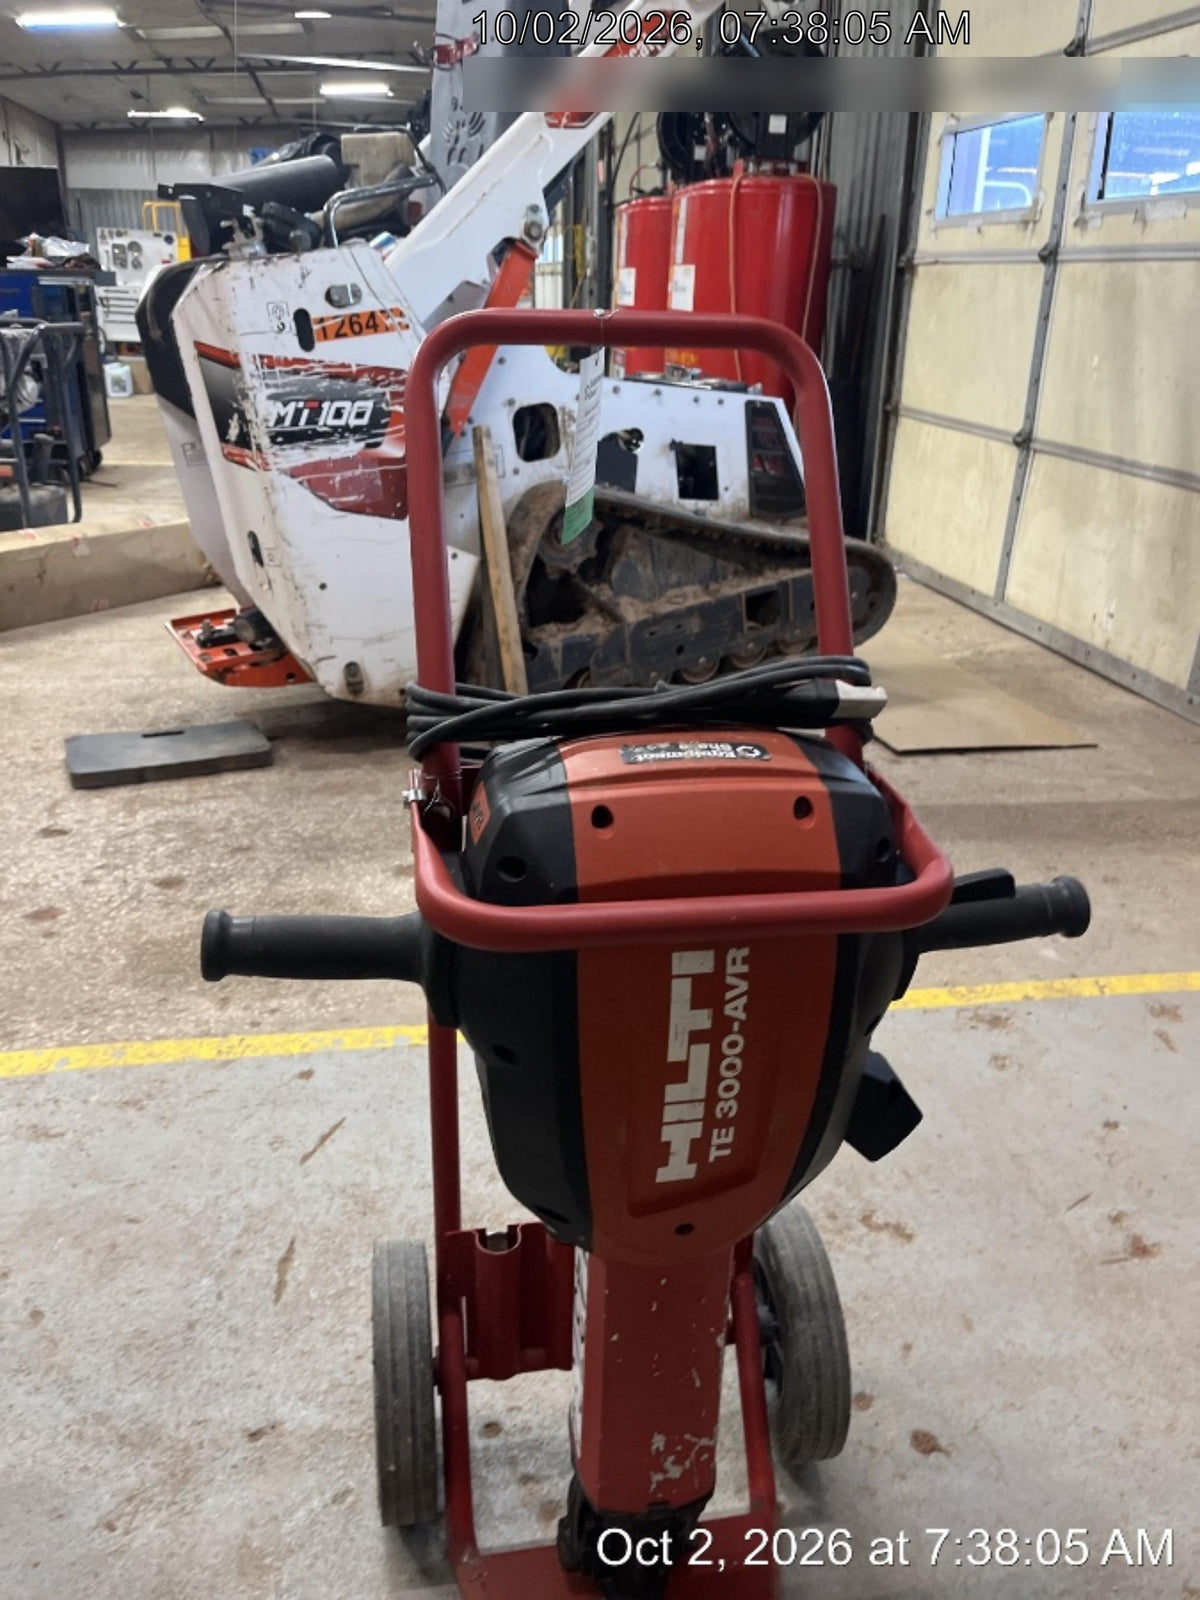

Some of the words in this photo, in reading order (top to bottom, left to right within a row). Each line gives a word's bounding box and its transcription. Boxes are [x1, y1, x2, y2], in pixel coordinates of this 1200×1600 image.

[656, 950, 715, 1183] HILTI
[715, 946, 750, 1120] 3000-AVR
[708, 1126, 735, 1164] TE
